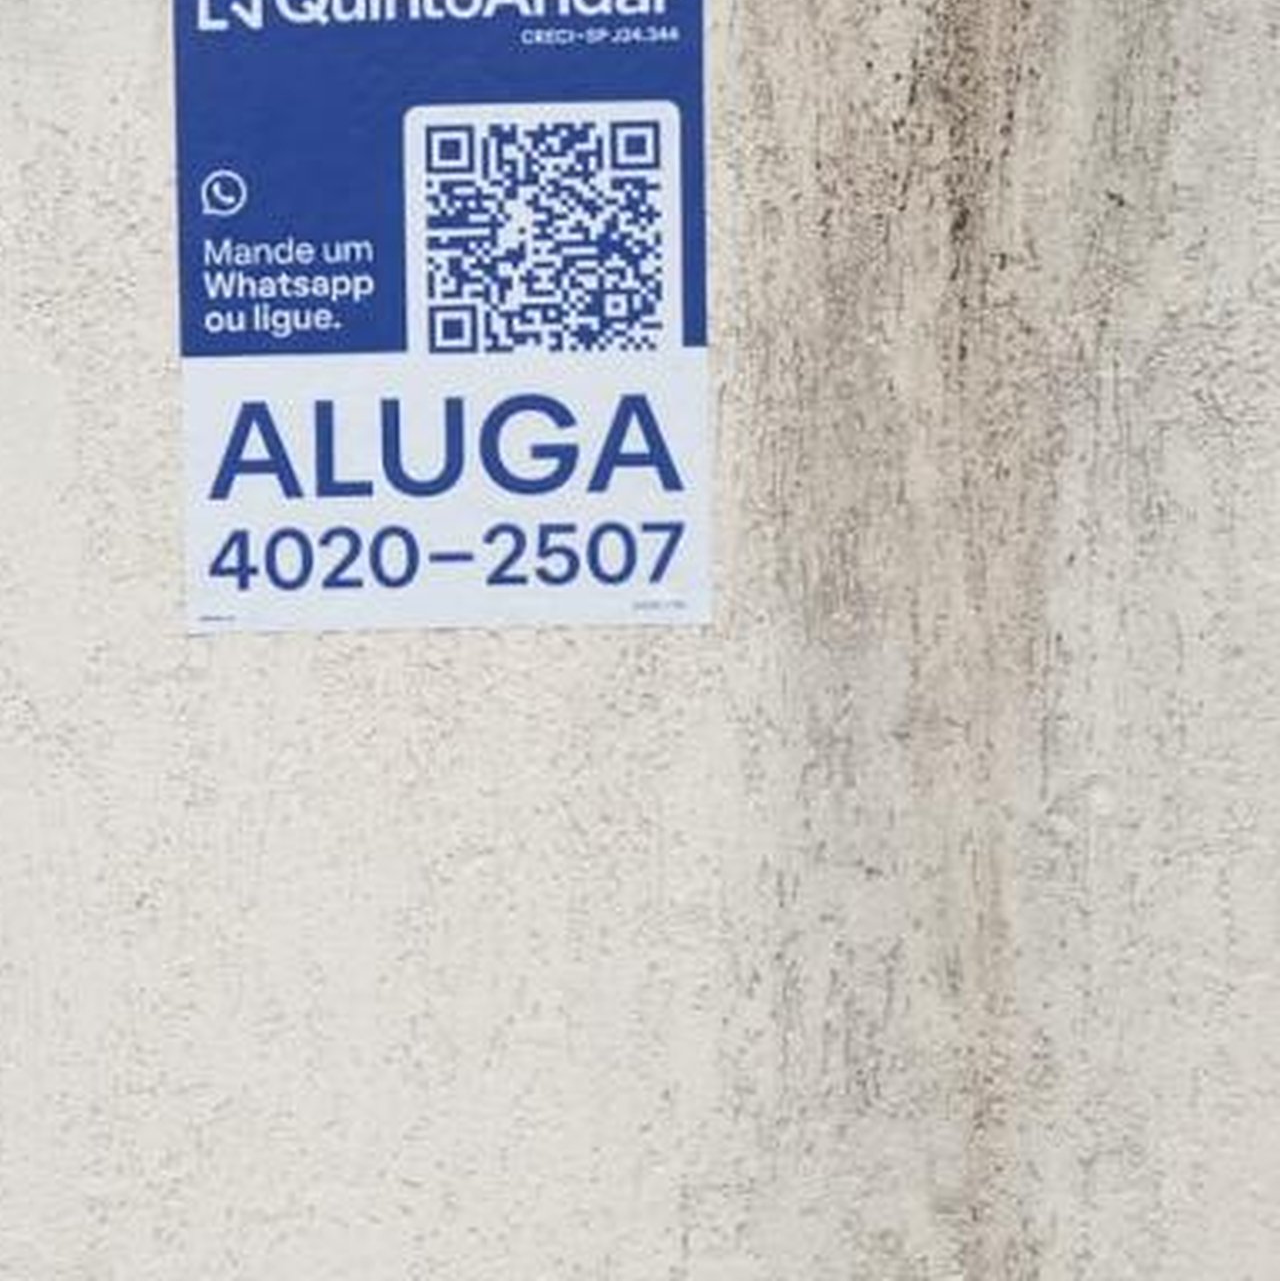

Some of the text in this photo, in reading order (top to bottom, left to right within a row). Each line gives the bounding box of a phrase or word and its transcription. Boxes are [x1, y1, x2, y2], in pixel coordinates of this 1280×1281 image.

[204, 237, 374, 266] Mande um
[203, 271, 375, 302] Whatsapp
[204, 302, 342, 338] ou ligue.
[208, 393, 684, 500] ALUGA
[208, 522, 686, 591] 4020-2507
